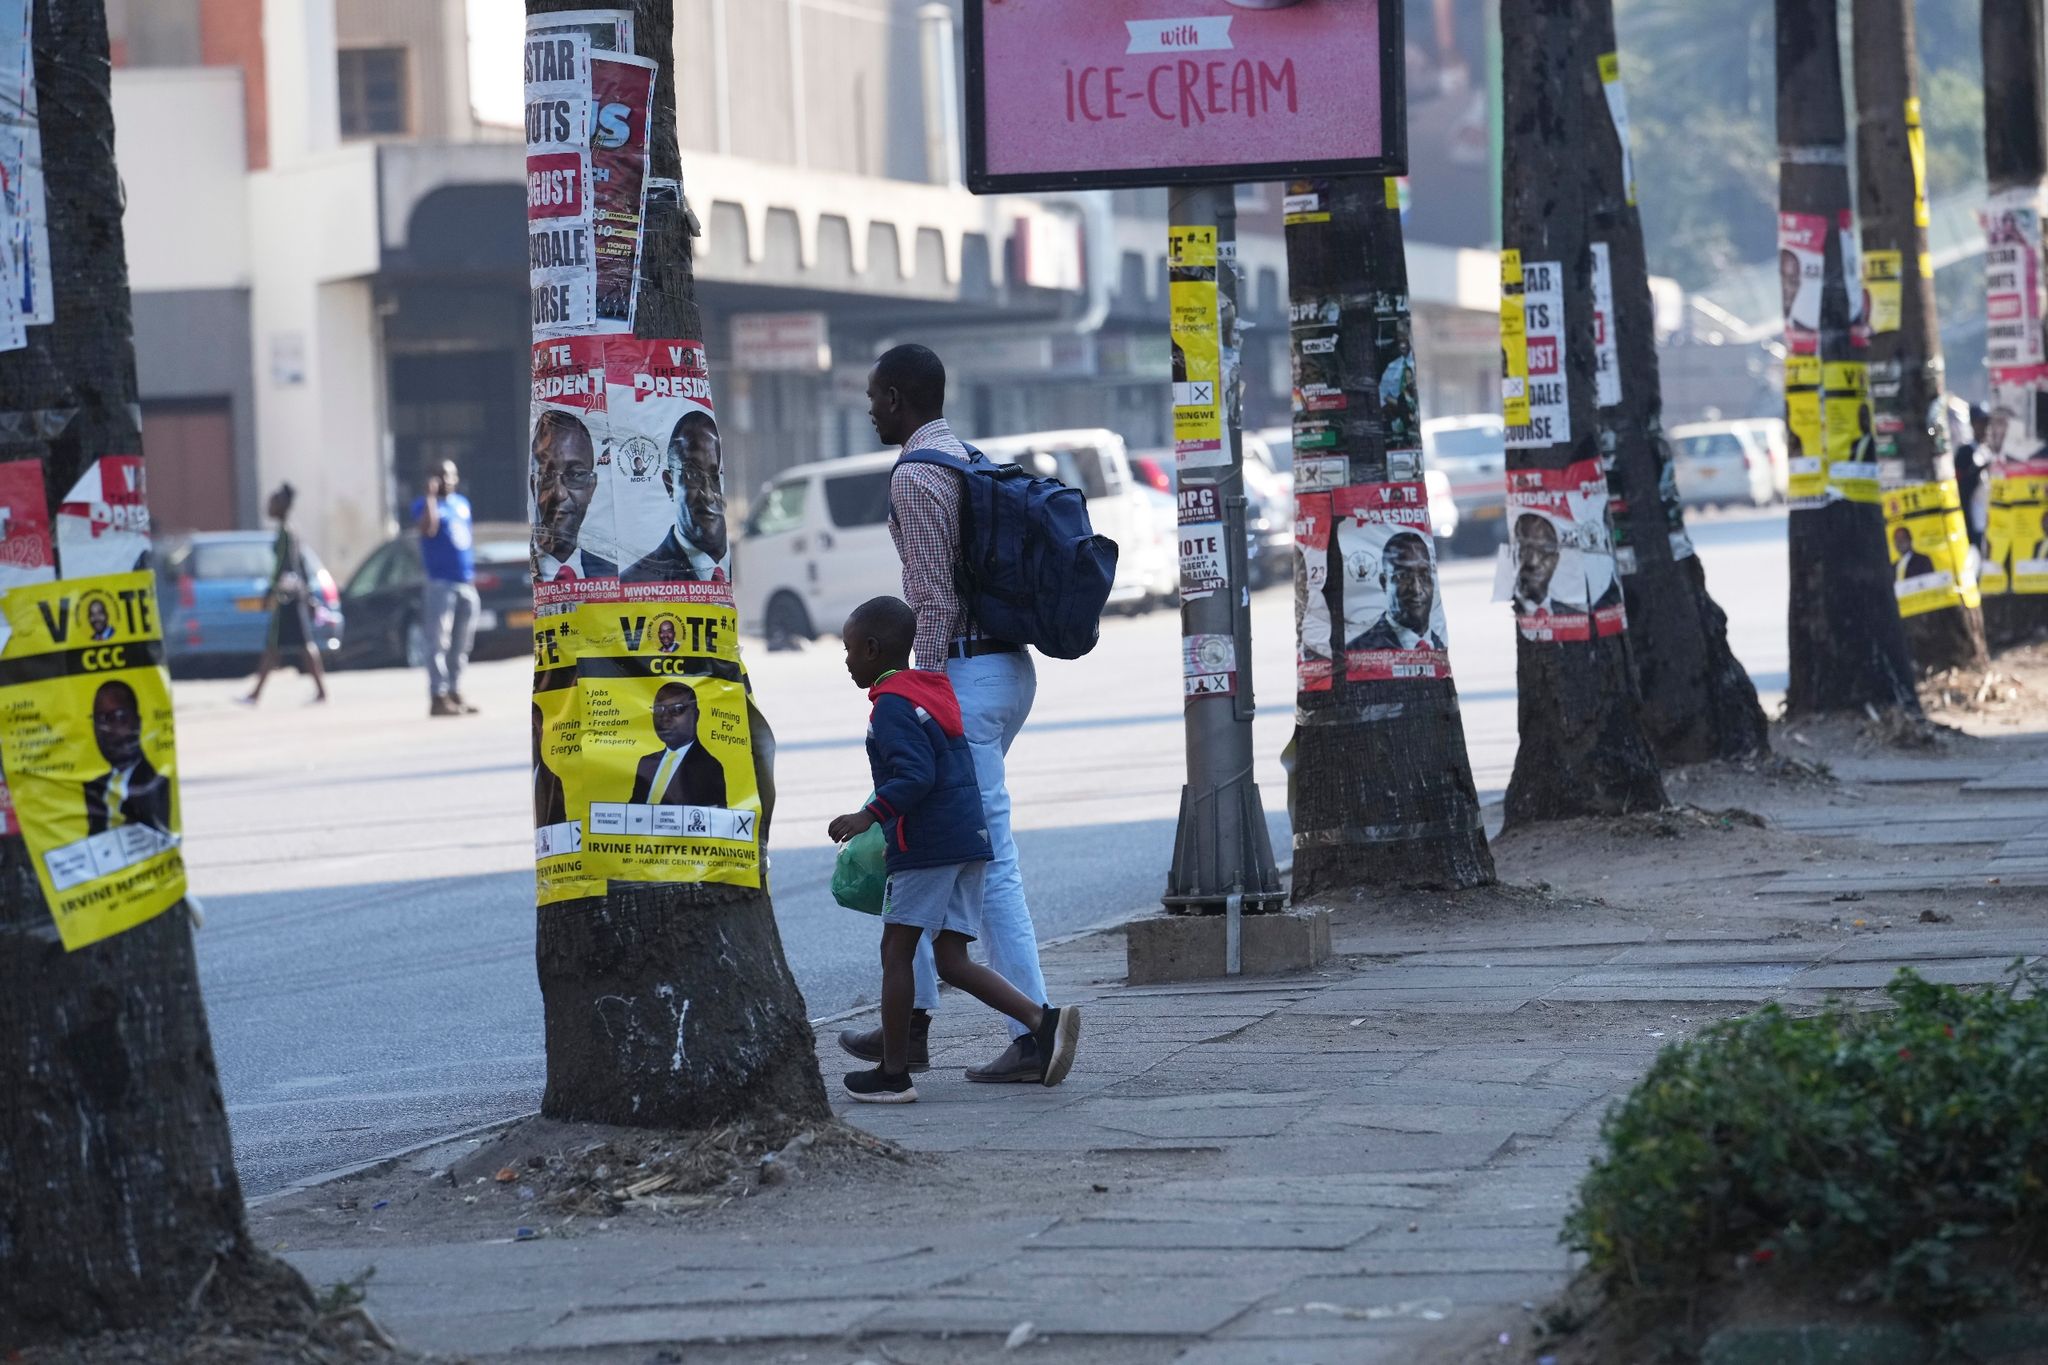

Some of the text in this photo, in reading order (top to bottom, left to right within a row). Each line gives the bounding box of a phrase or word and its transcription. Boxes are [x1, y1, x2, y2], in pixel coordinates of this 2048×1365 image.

[1160, 25, 1198, 46] with
[1065, 57, 1298, 128] ICE-CREAM
[608, 242, 632, 250] TICKETS
[654, 367, 676, 377] THE
[1211, 559, 1218, 568] A
[624, 585, 687, 597] MWONZORA
[689, 584, 724, 595] DOUGLAS
[81, 647, 127, 671] CCC
[650, 658, 685, 675] CCC
[590, 690, 608, 698] Jobs
[711, 707, 740, 724] Winning
[593, 719, 629, 727] Freedom
[722, 720, 735, 732] For
[561, 731, 576, 742] For
[711, 730, 748, 746] Everyone!
[551, 744, 582, 755] Everyo
[588, 842, 756, 861] IRVINE HATITYE NYANINGWE
[639, 858, 668, 866] HARARE
